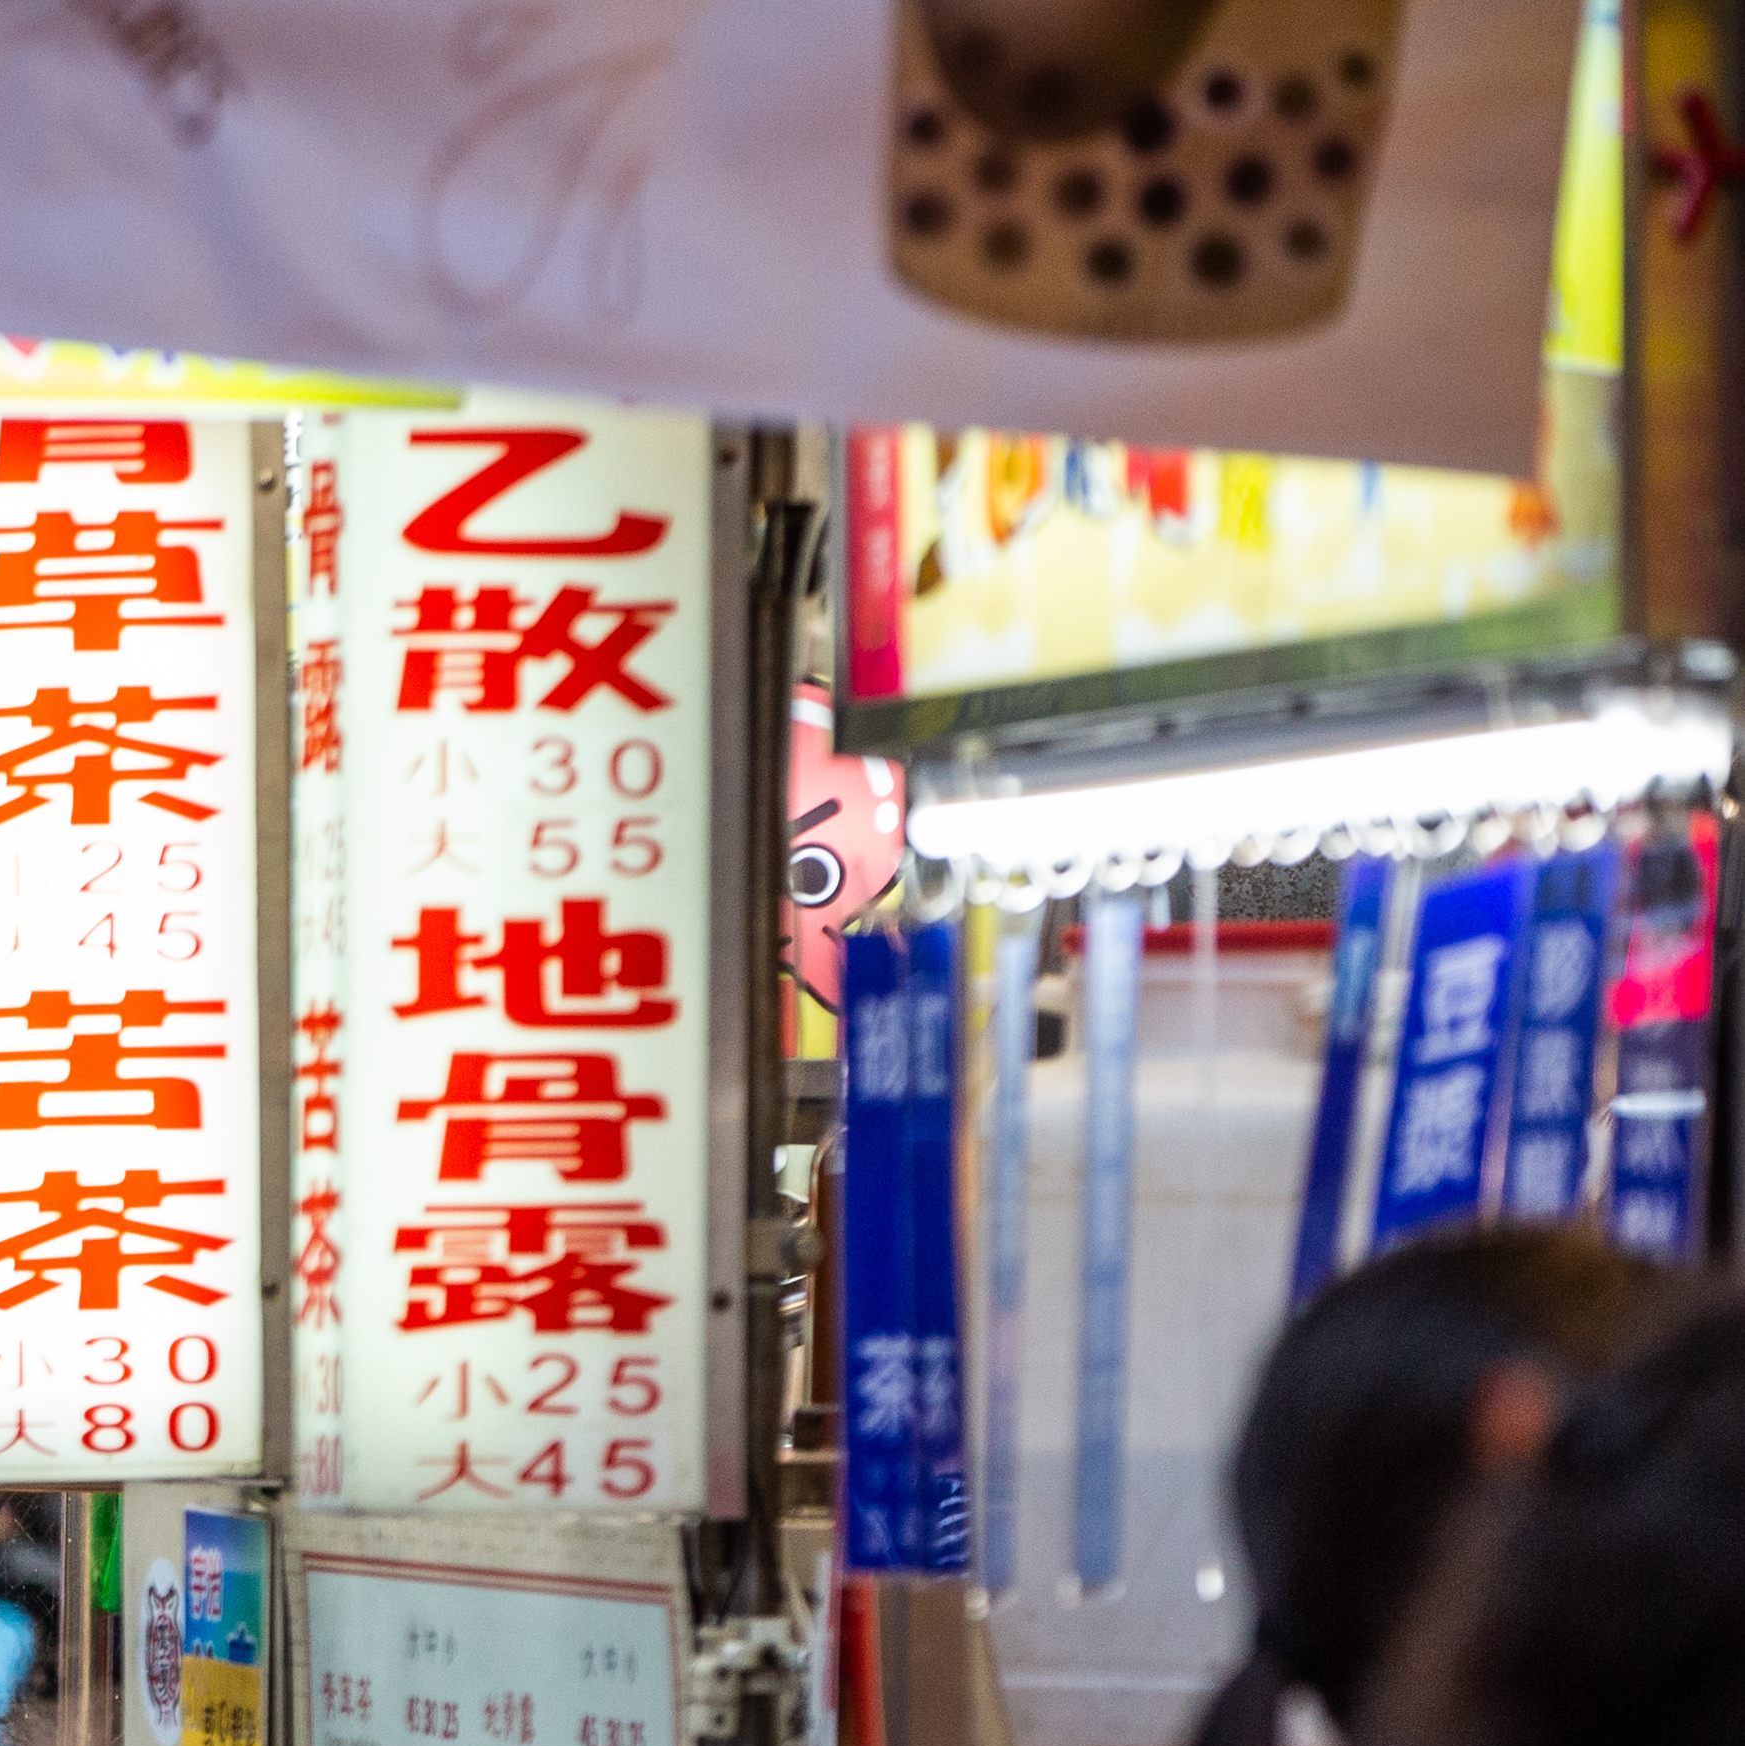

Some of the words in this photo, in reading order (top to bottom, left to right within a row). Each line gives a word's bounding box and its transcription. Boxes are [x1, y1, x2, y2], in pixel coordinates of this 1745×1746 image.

[293, 996, 345, 1330] 苦茶
[390, 897, 679, 1335] 地骨露
